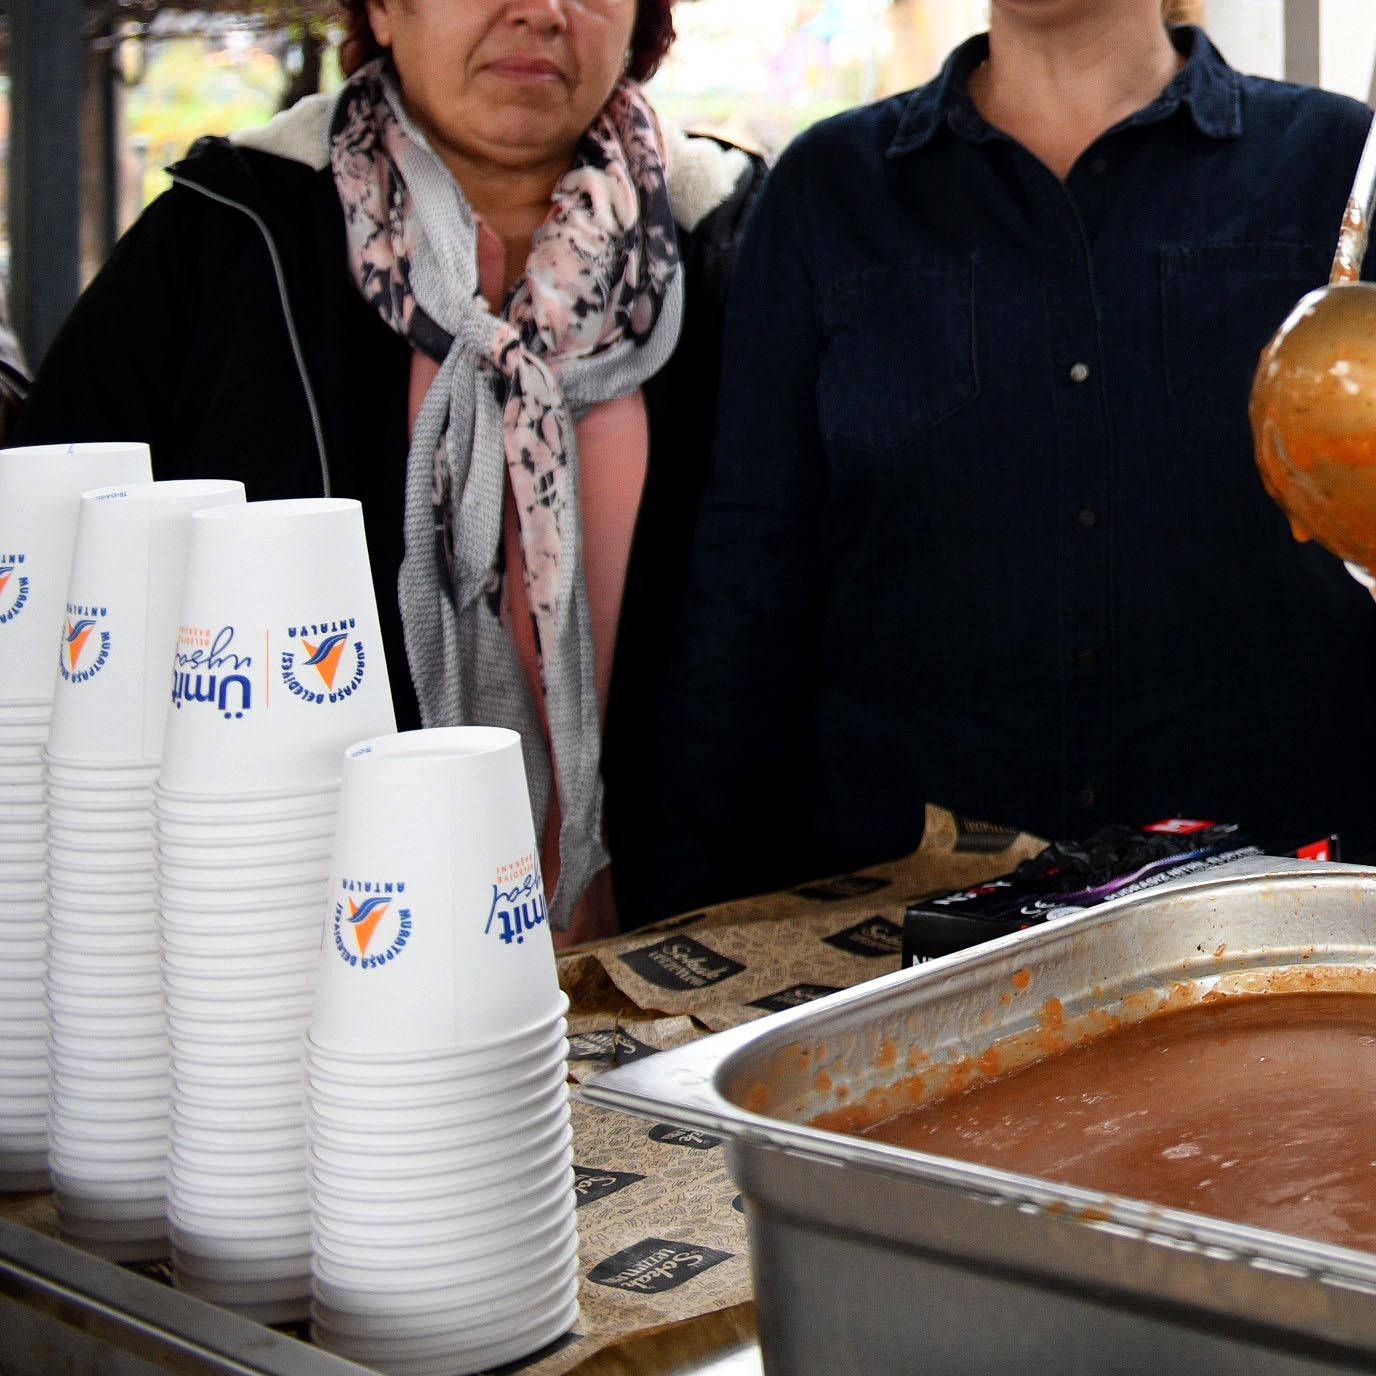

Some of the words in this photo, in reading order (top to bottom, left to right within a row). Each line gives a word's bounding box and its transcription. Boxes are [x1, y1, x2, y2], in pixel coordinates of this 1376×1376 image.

[288, 617, 355, 638] ANTALYA
[329, 640, 366, 704] MURATPAŞA
[342, 878, 405, 894] ANTALYA
[361, 909, 412, 969] MURATPAŞA
[497, 894, 548, 944] mit
[620, 1251, 704, 1289] Sokak
